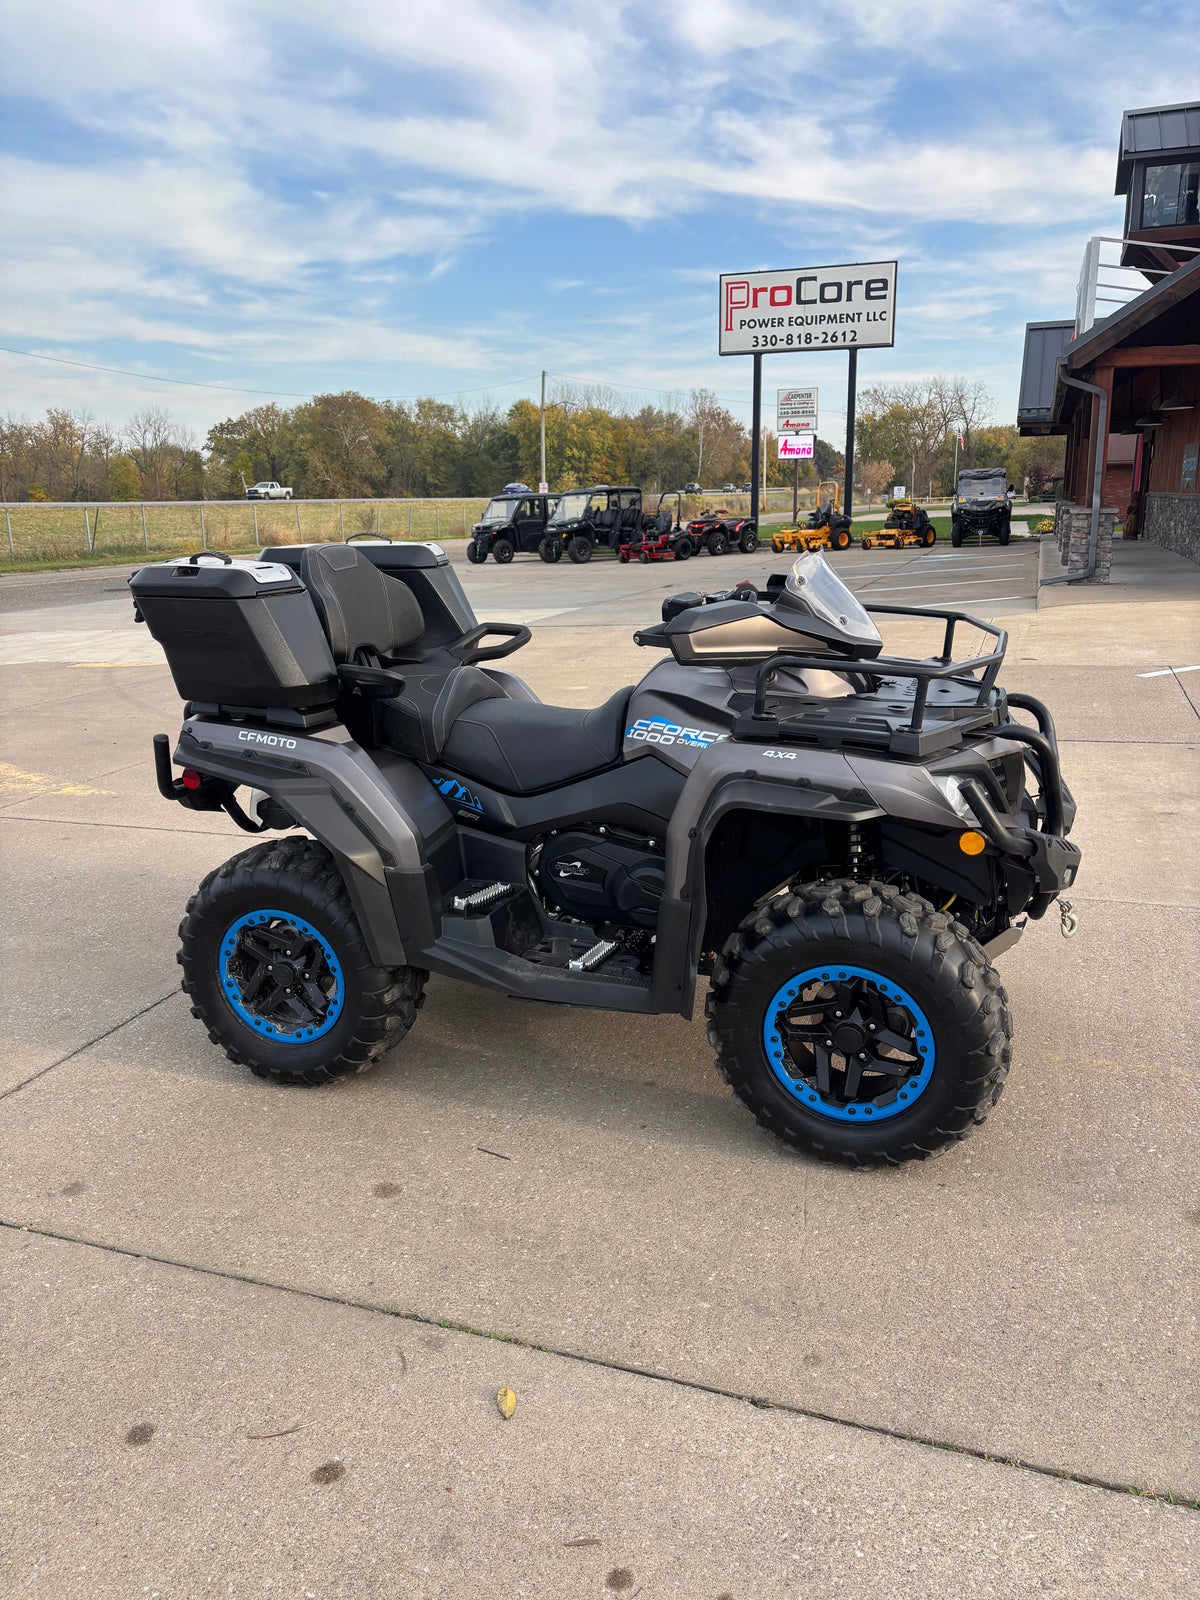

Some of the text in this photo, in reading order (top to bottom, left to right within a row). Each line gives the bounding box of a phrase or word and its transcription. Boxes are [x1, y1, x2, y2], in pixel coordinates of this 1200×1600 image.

[725, 276, 888, 331] ProCore
[739, 311, 887, 330] POWER EQUIPMENT LLC
[752, 330, 858, 347] 330-818-2612
[788, 392, 812, 400] CARPENTER
[782, 420, 811, 428] Amana
[779, 439, 813, 456] Amana
[238, 731, 297, 749] CFMOTO
[626, 728, 675, 745] 1000
[762, 750, 798, 760] 4X4
